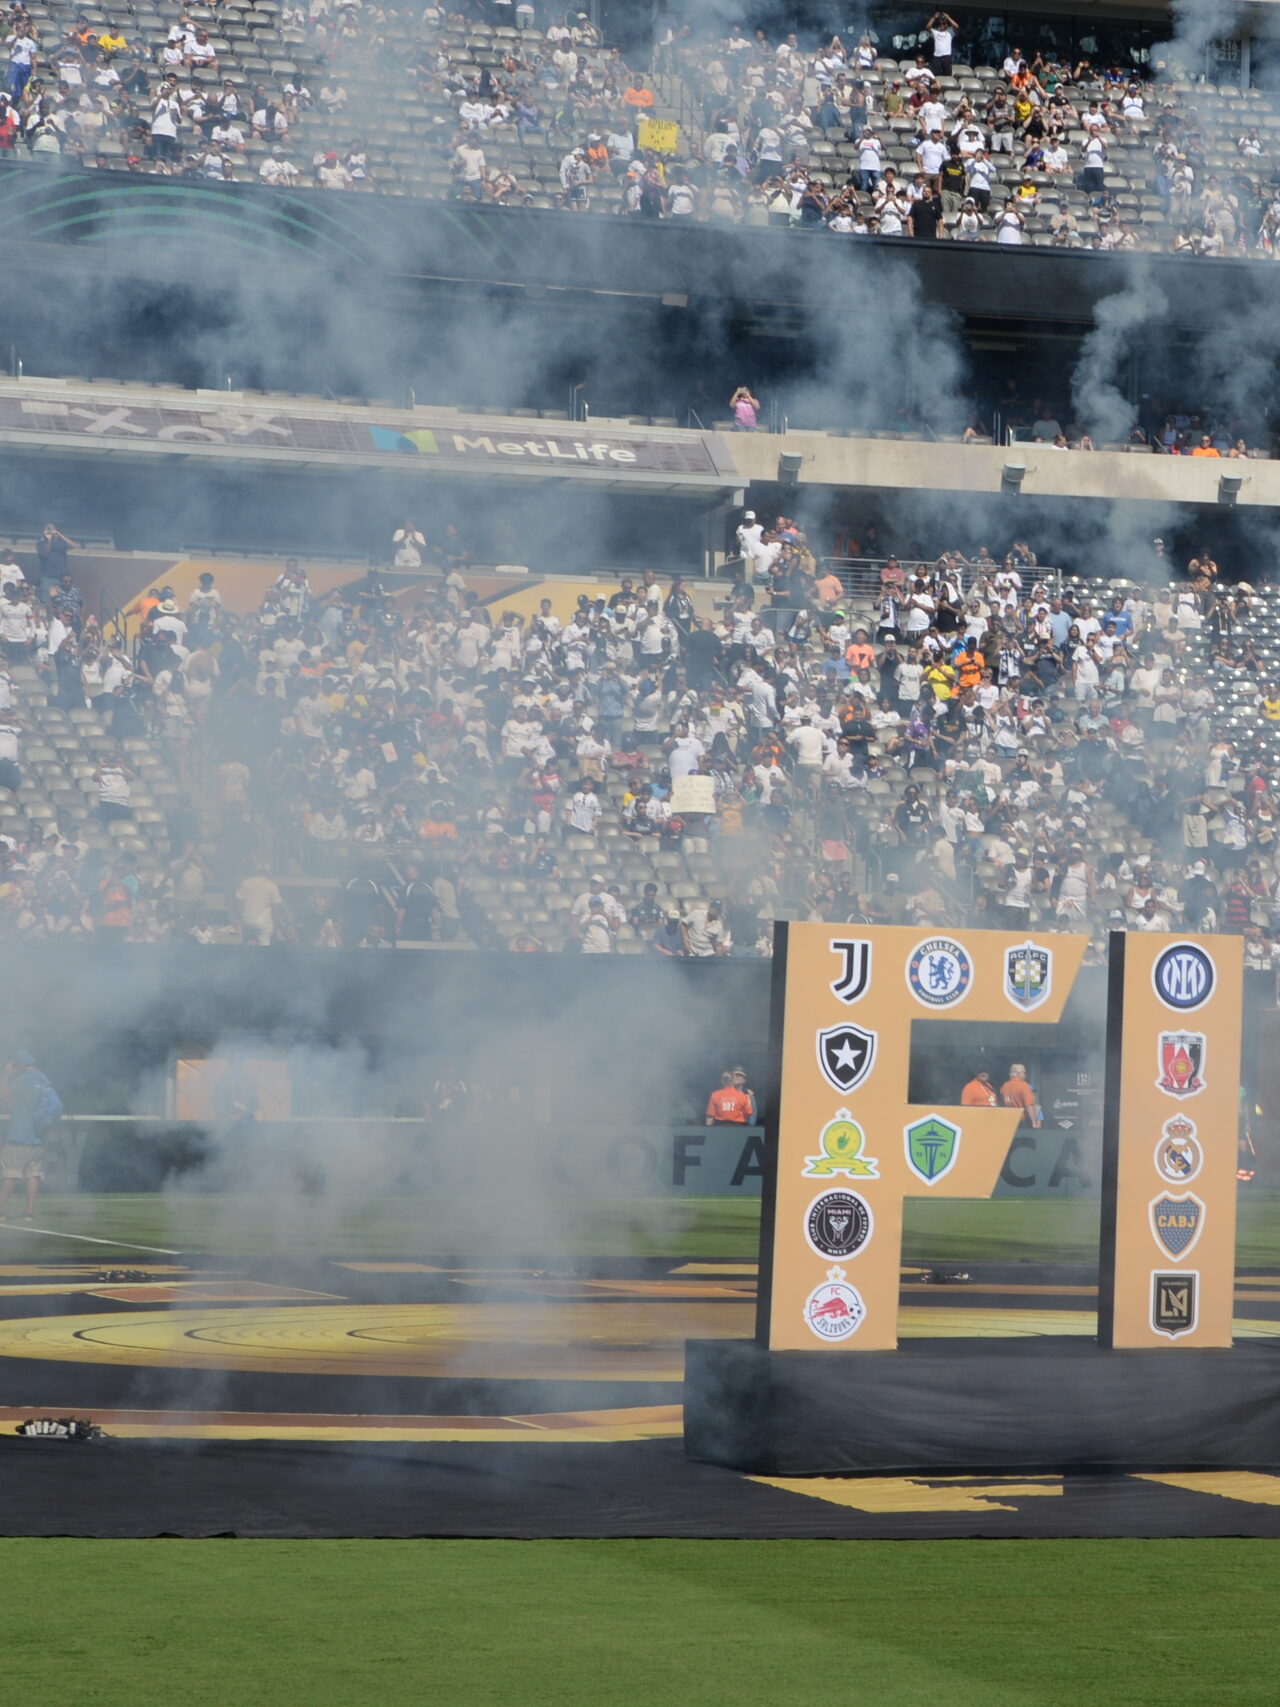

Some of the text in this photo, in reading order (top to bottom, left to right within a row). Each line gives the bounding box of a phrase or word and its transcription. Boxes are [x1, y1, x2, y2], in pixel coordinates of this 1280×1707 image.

[452, 435, 637, 462] MetLife
[920, 941, 960, 957] CHELSEA
[1158, 1215, 1195, 1228] CABJ
[831, 1287, 841, 1295] FC
